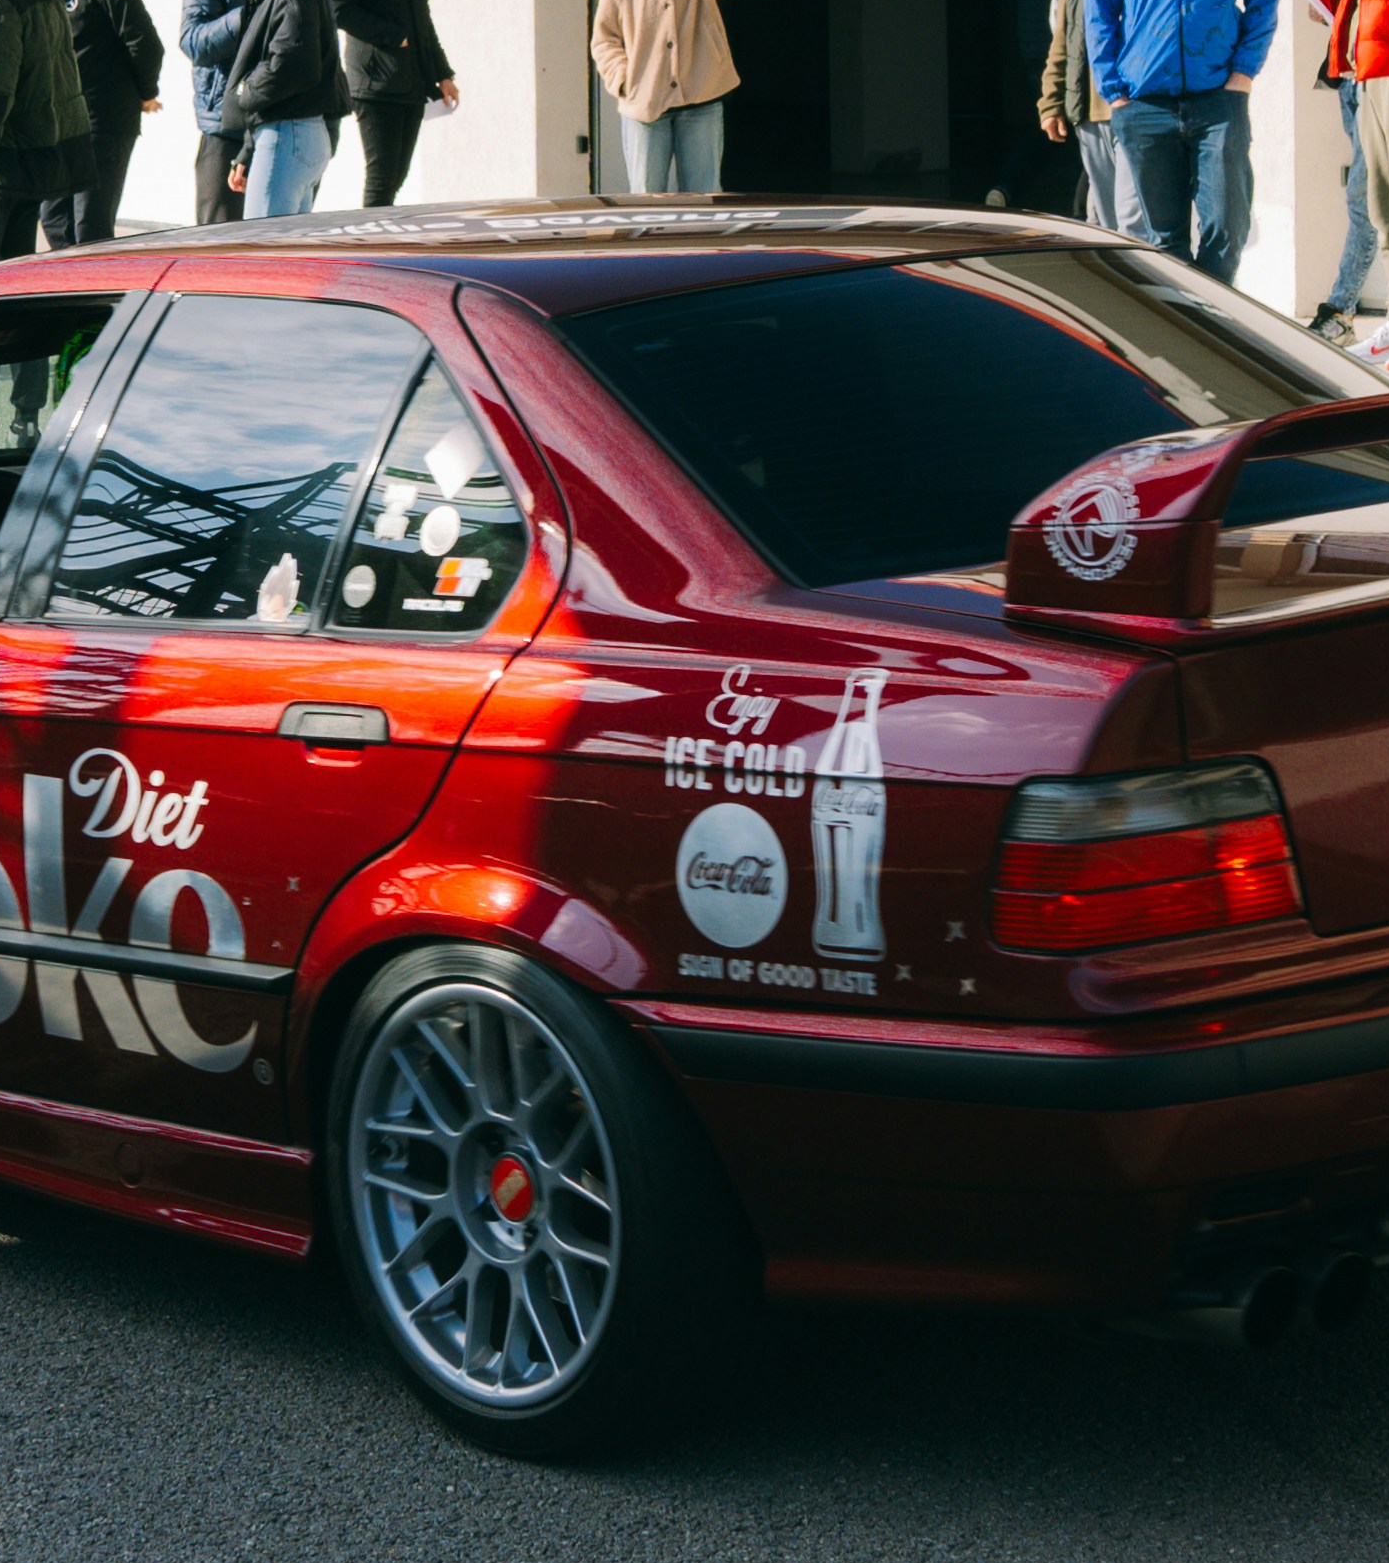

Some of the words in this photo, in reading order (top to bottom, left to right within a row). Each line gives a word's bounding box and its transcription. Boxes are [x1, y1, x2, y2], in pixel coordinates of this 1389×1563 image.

[706, 664, 781, 735] Enjoy
[69, 748, 210, 850] Diet
[664, 736, 716, 791] ICE
[723, 740, 807, 798] COLD
[678, 953, 724, 980] SIGN
[727, 958, 754, 982] OF
[757, 961, 817, 989] GOOD
[819, 967, 878, 995] TASTE
